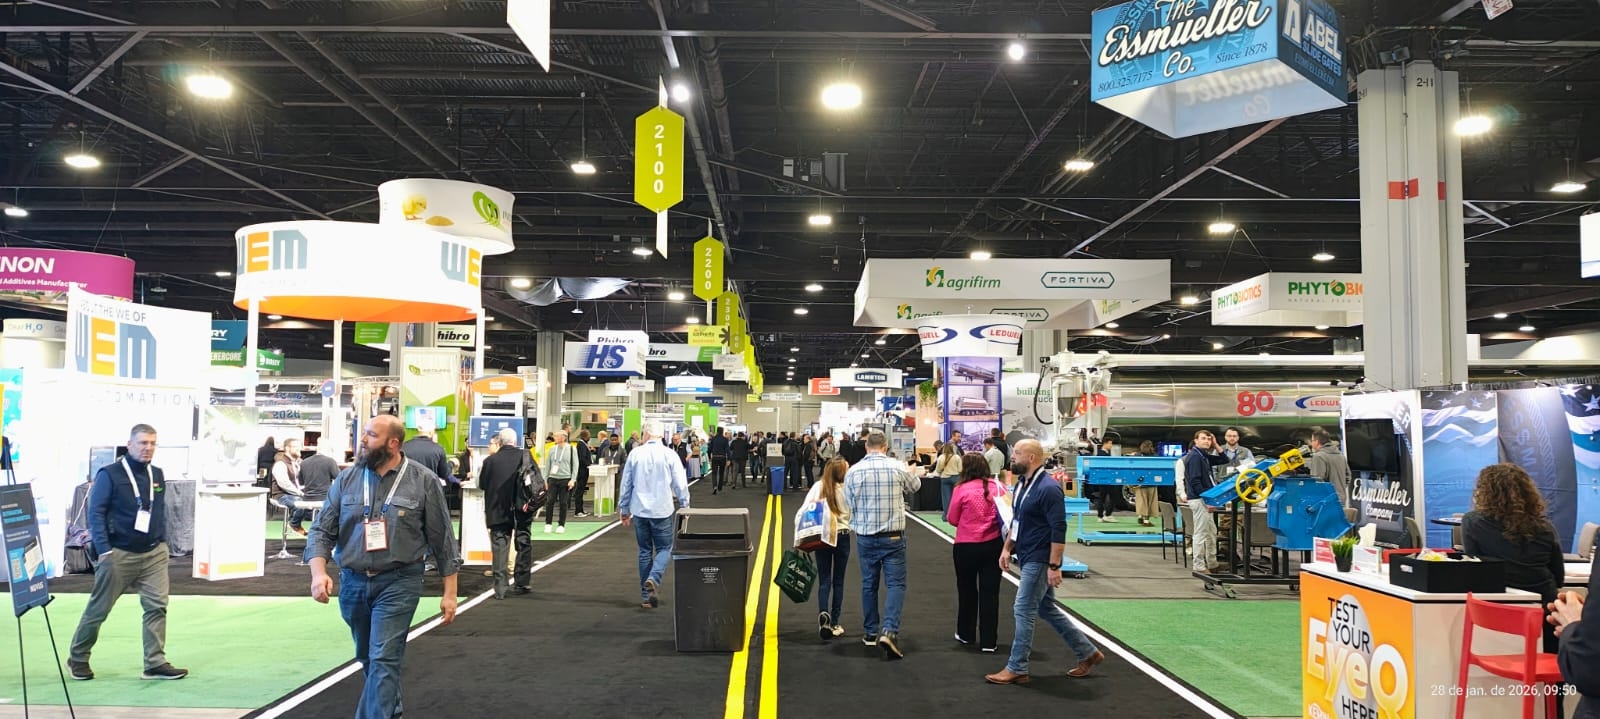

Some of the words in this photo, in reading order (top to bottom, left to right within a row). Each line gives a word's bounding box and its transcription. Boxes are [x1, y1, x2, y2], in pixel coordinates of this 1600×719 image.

[1155, 0, 1195, 22] The
[1098, 0, 1272, 67] Essmueller
[1303, 10, 1342, 63] ABEL
[1163, 51, 1196, 78] Co.
[1215, 52, 1241, 64] Since
[1244, 42, 1268, 57] 1878
[1302, 41, 1322, 62] SLIDE
[1321, 54, 1342, 77] GATES
[653, 124, 665, 194] 2100
[3, 278, 36, 286] Additives
[36, 279, 88, 289] Manufacer
[946, 275, 1001, 291] agrifirm
[1050, 276, 1106, 284] FORTIVA
[1217, 284, 1262, 309] PHYTOBIOTICS
[132, 311, 147, 322] OF
[75, 310, 157, 380] WEM
[211, 329, 228, 338] RY
[437, 331, 470, 341] hibro
[648, 347, 667, 356] bro
[1236, 390, 1274, 417] 80
[1352, 478, 1412, 507] Essmueller
[1365, 503, 1393, 523] Company
[1328, 597, 1359, 625] TEST
[1333, 620, 1371, 654] YOUR
[1307, 616, 1408, 719] EyeQ
